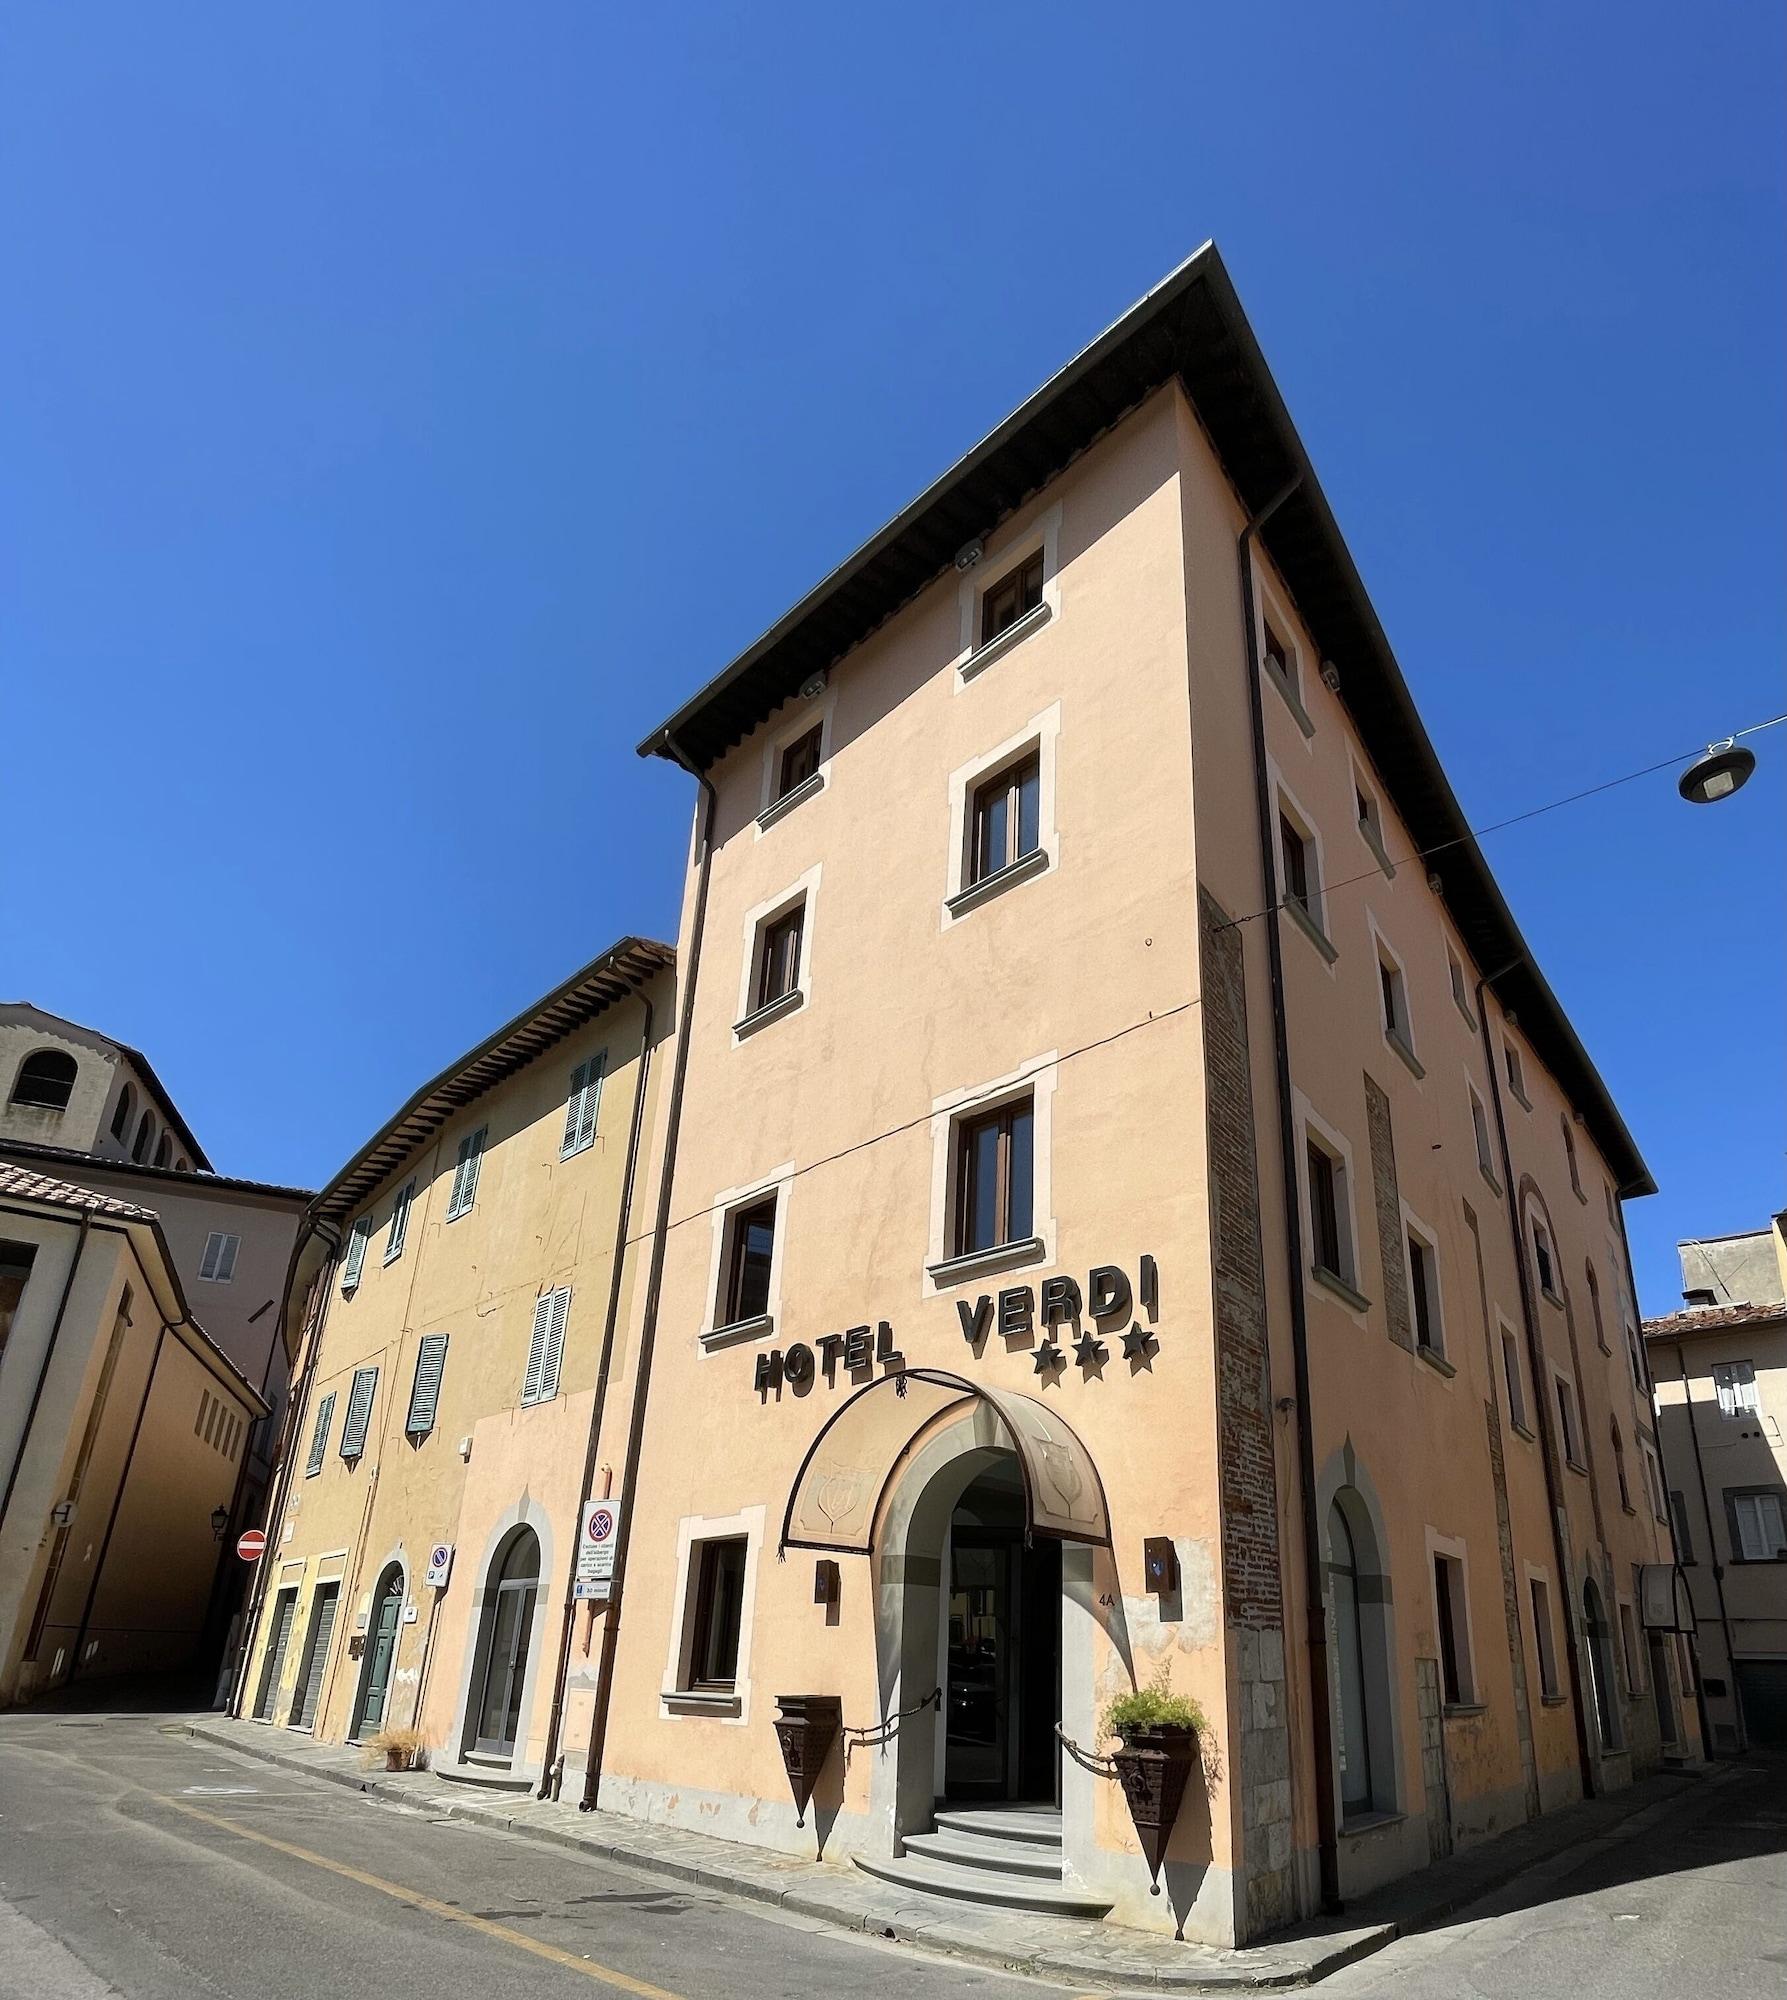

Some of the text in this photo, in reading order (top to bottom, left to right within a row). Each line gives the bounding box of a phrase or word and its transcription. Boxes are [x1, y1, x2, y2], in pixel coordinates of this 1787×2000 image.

[754, 1254, 1157, 1393] HOTEL VERDI
[1099, 1593, 1115, 1606] 4A
